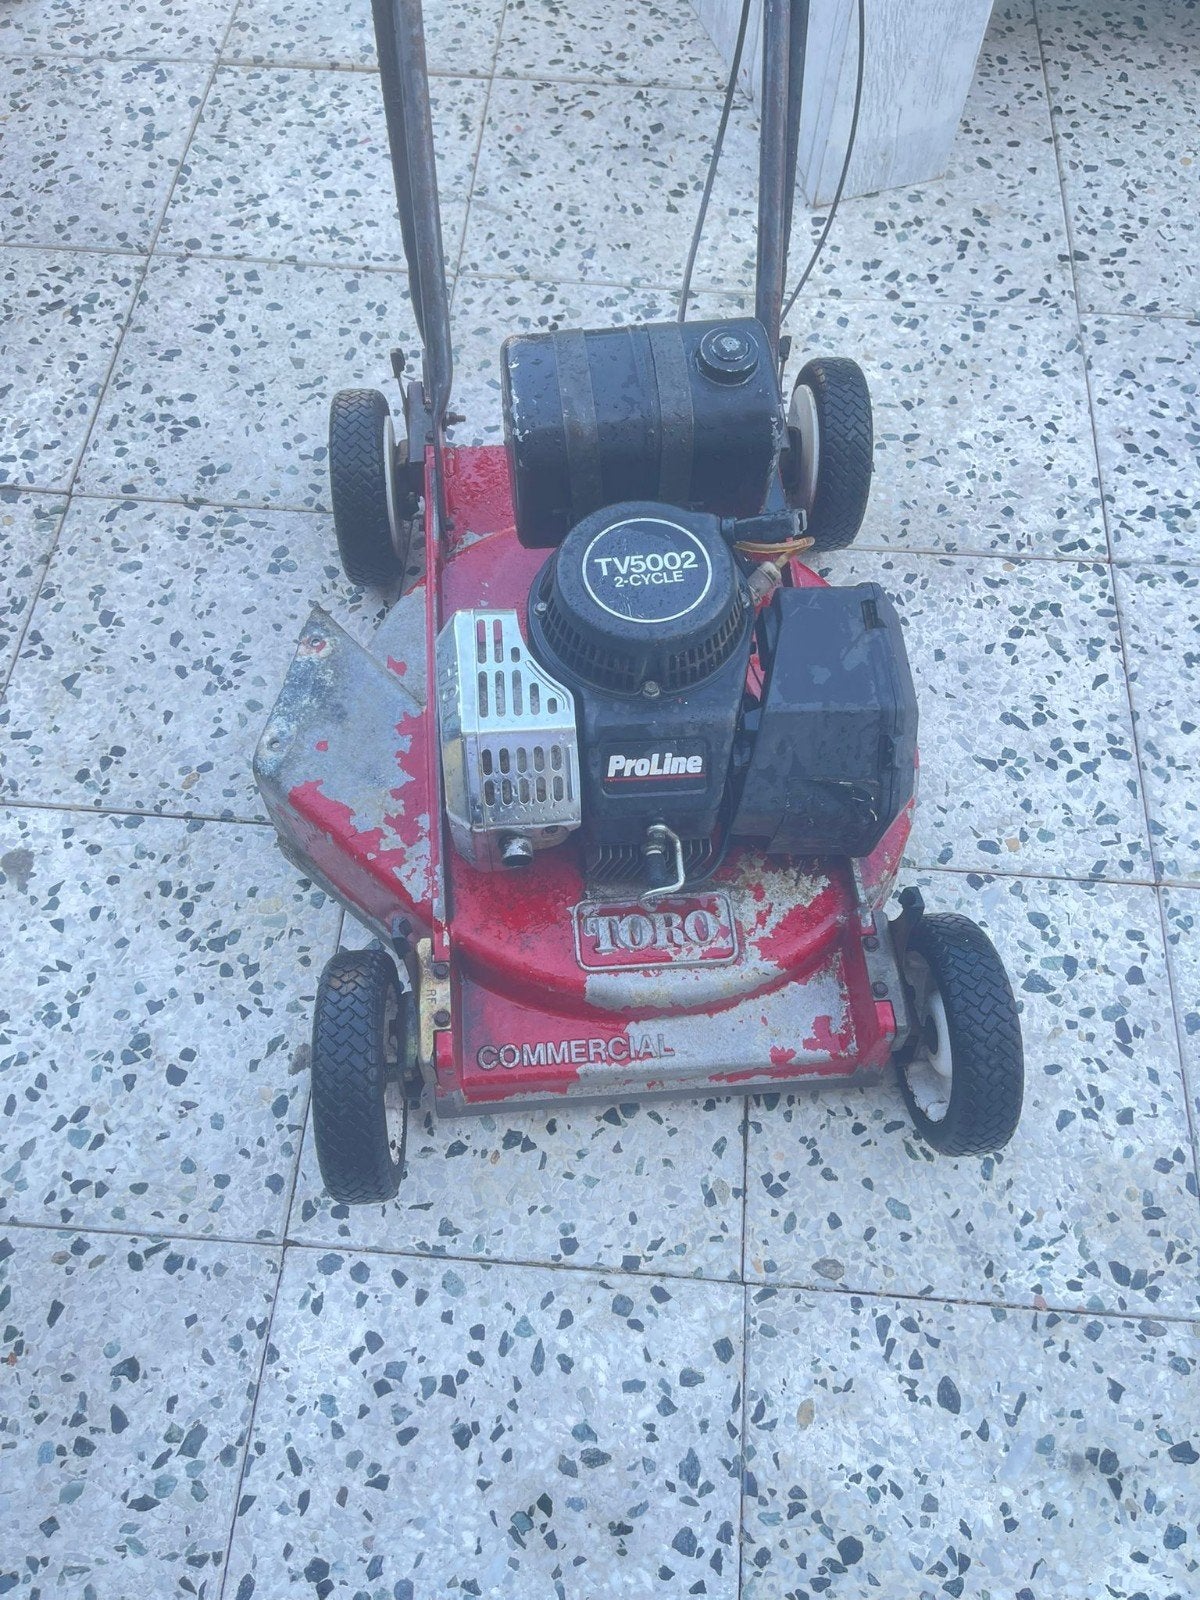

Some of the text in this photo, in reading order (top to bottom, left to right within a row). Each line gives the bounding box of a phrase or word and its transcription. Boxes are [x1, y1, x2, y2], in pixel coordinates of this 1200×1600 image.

[594, 551, 698, 576] TV5002
[613, 570, 685, 588] 2-CYCLE
[607, 752, 703, 777] ProLine
[583, 909, 721, 953] TORO
[476, 1033, 675, 1070] COMMERCIAL
